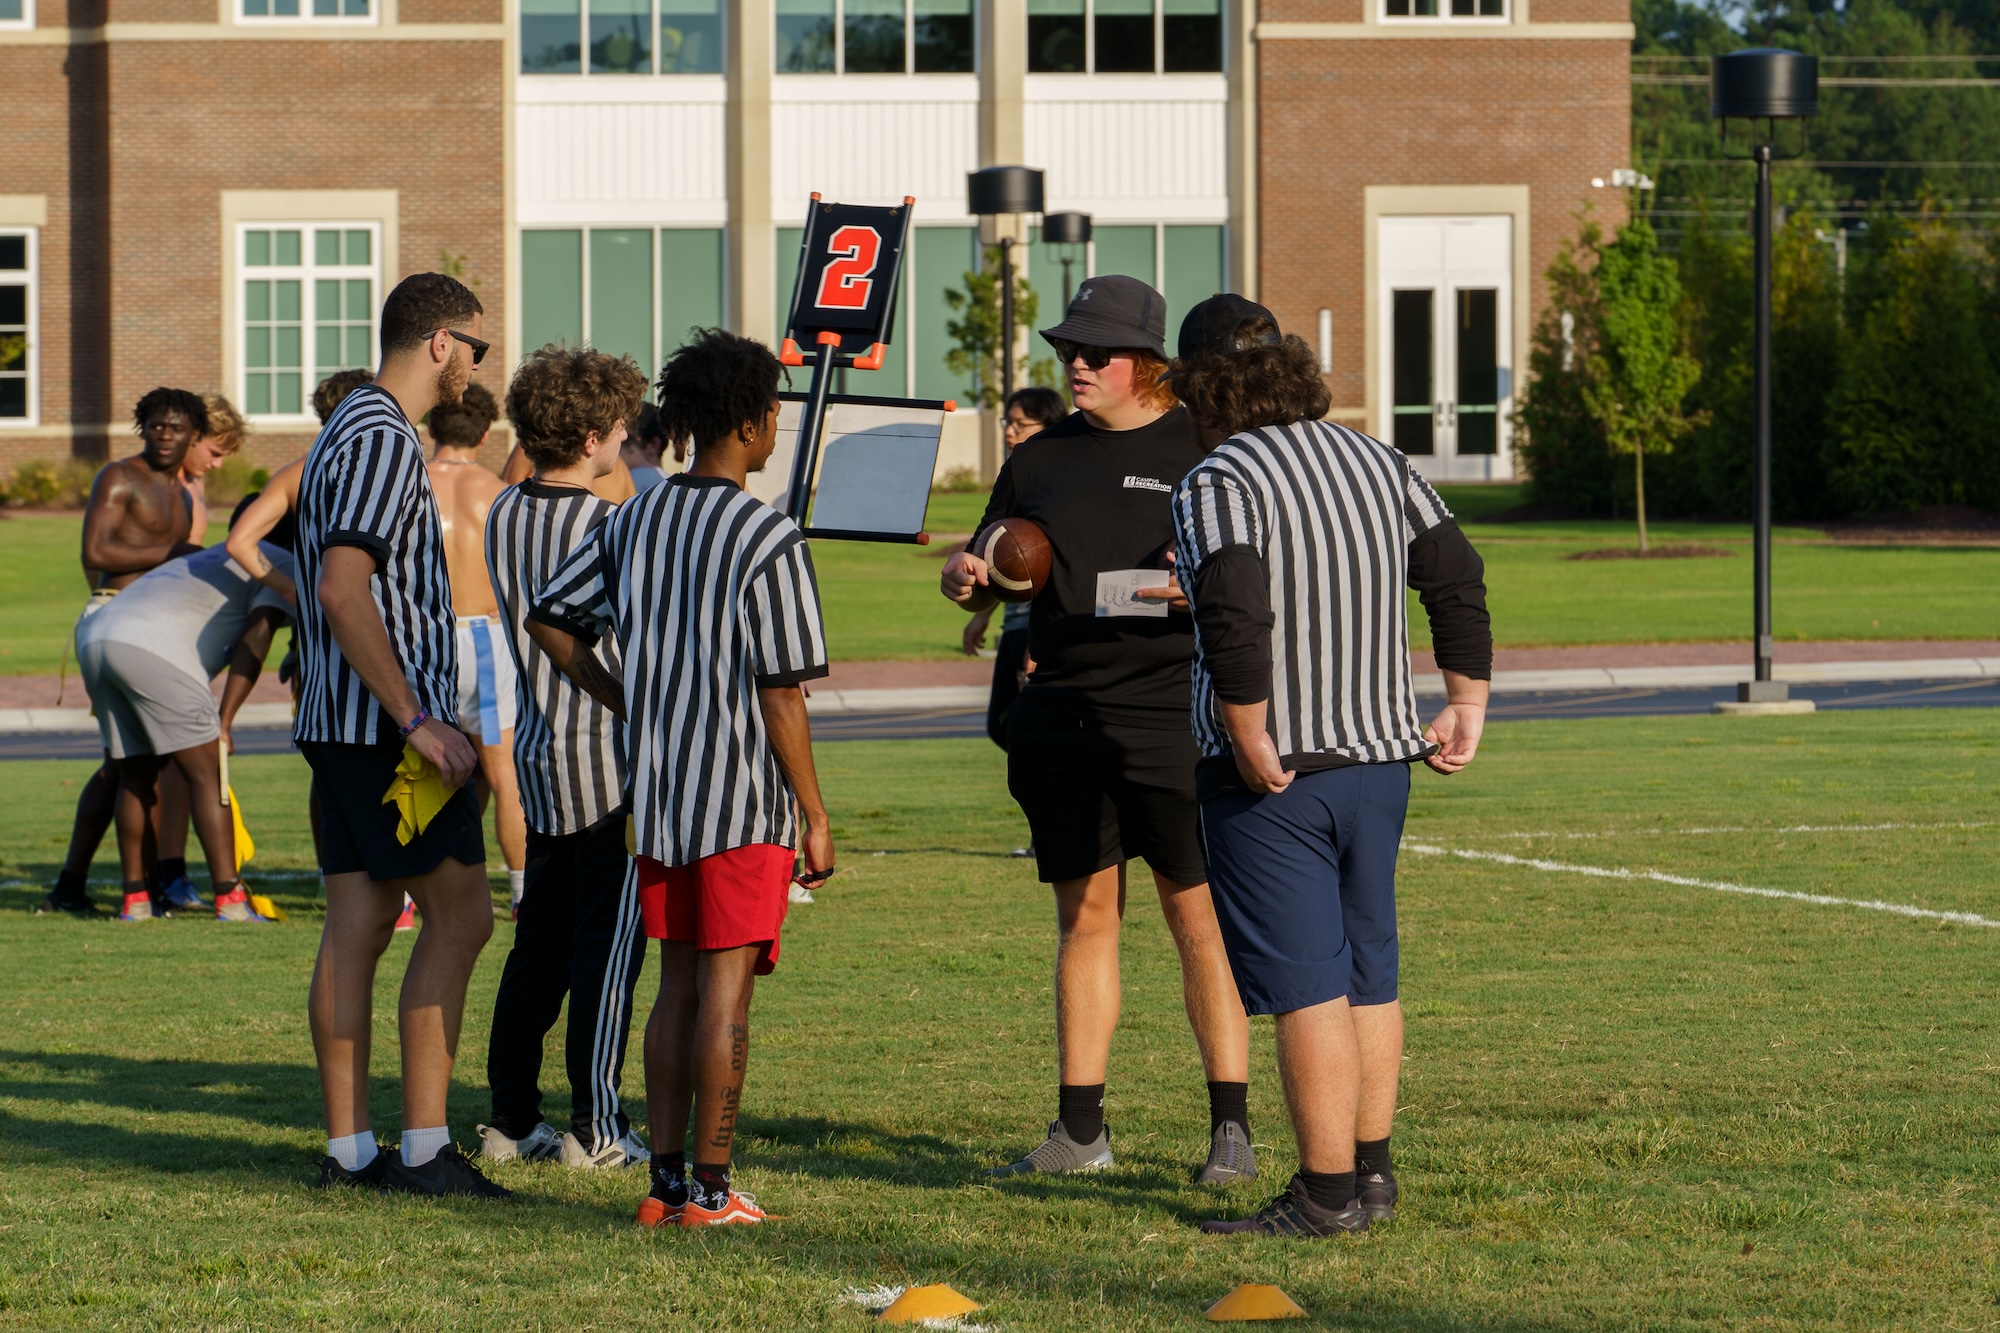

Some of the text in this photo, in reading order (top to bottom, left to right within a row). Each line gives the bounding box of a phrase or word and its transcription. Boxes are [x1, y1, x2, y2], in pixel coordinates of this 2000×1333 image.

[814, 225, 882, 310] 2
[1136, 476, 1160, 484] CAMPUS
[1135, 481, 1172, 490] RECREATION
